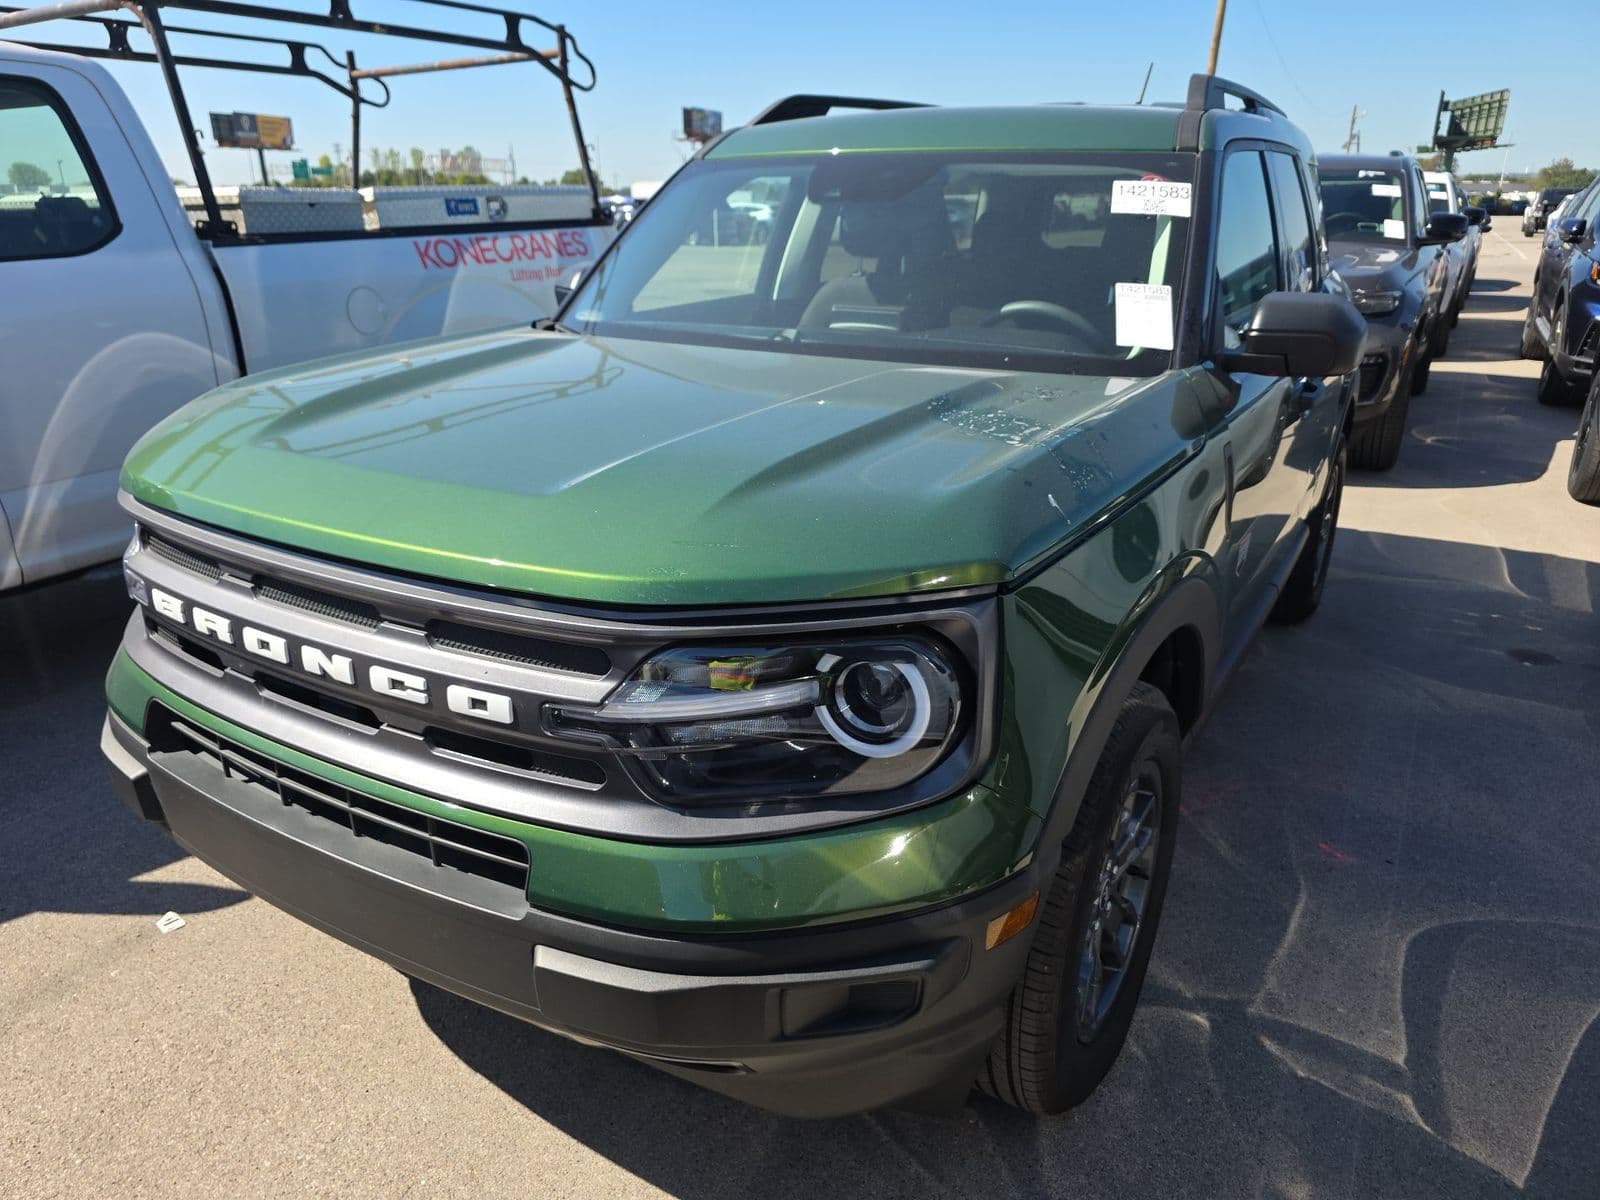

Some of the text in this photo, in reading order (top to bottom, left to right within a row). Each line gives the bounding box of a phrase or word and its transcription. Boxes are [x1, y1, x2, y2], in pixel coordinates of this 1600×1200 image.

[1119, 184, 1190, 200] 1421583
[412, 231, 589, 270] KONECRANES
[151, 587, 514, 725] BRONCO
